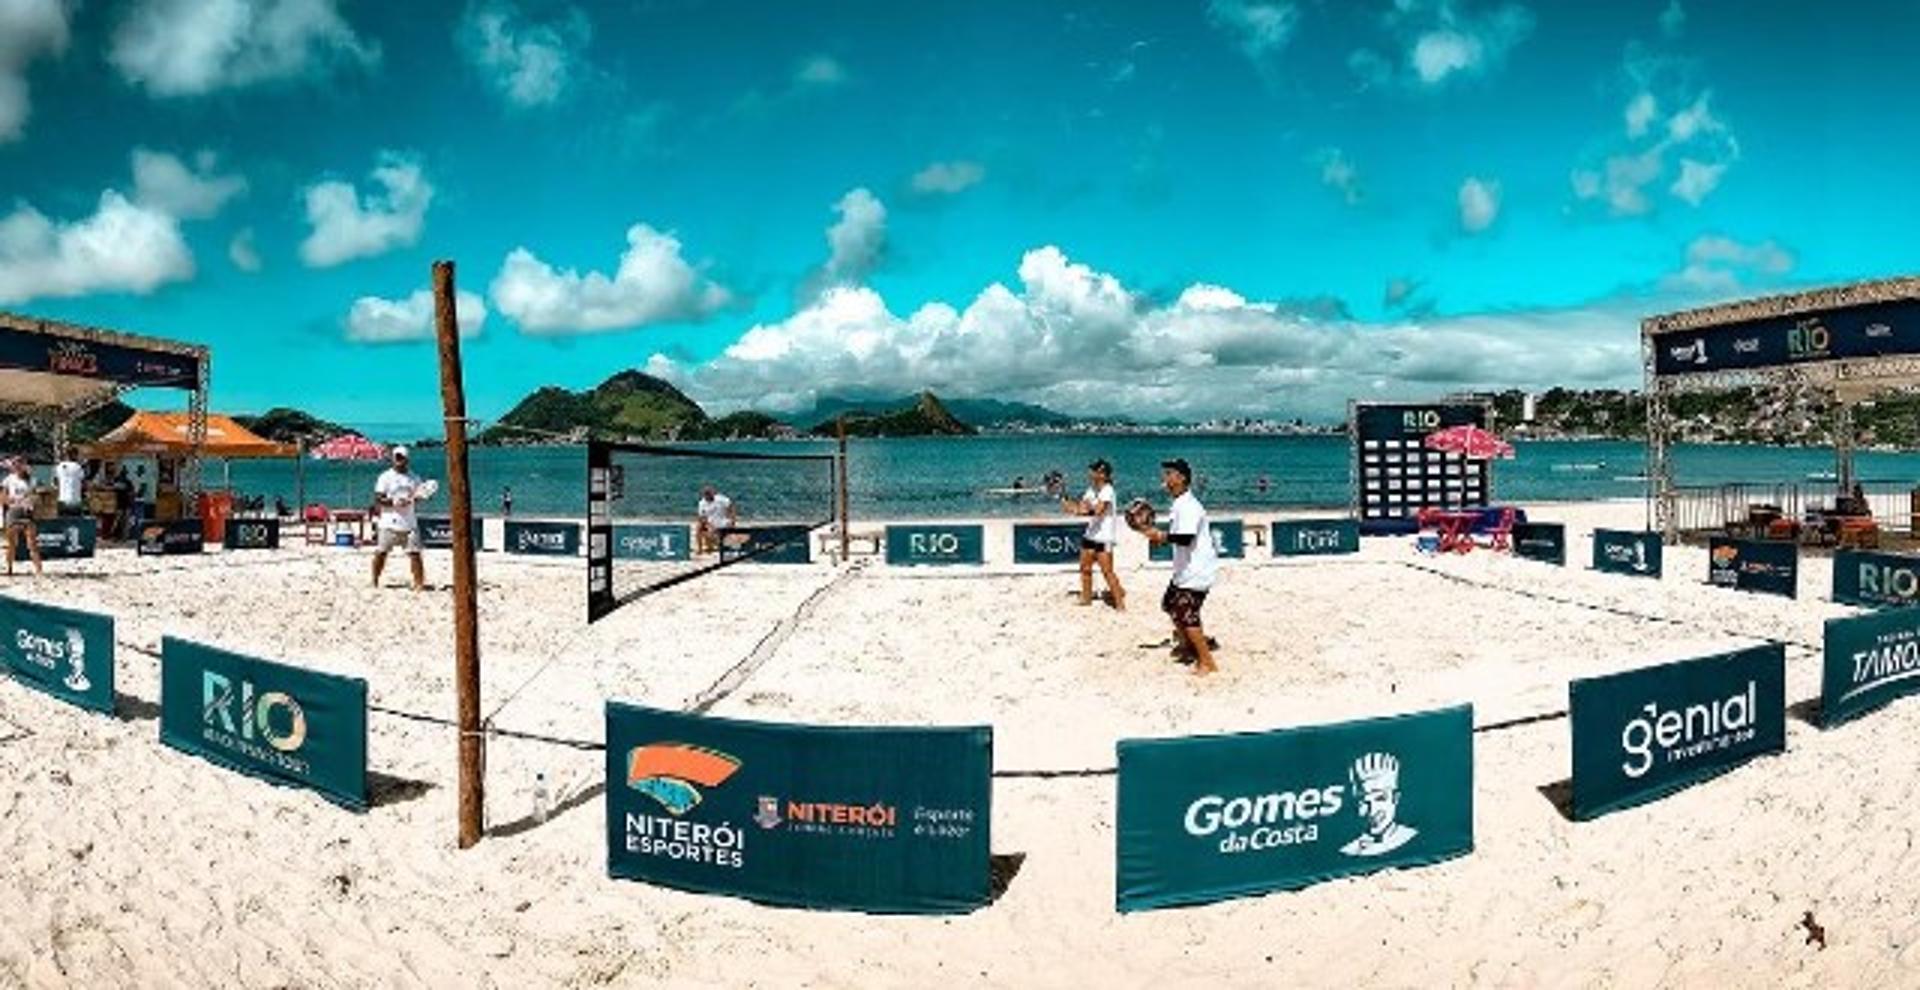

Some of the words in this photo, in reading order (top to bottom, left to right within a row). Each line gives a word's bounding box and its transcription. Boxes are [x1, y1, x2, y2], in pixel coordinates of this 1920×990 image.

[1787, 324, 1829, 352] RIO
[1403, 410, 1440, 427] RIO
[911, 533, 958, 553] RIO
[1859, 562, 1917, 597] RIO
[1853, 641, 1920, 682] TAMO
[203, 669, 307, 752] RIO
[1622, 680, 1756, 778] genial
[787, 800, 896, 827] NITERÓI
[1184, 784, 1345, 836] Gomes
[626, 812, 744, 850] NITERÓI
[1219, 831, 1248, 853] da
[1250, 824, 1318, 850] Costa
[626, 833, 743, 868] ESPORTES
